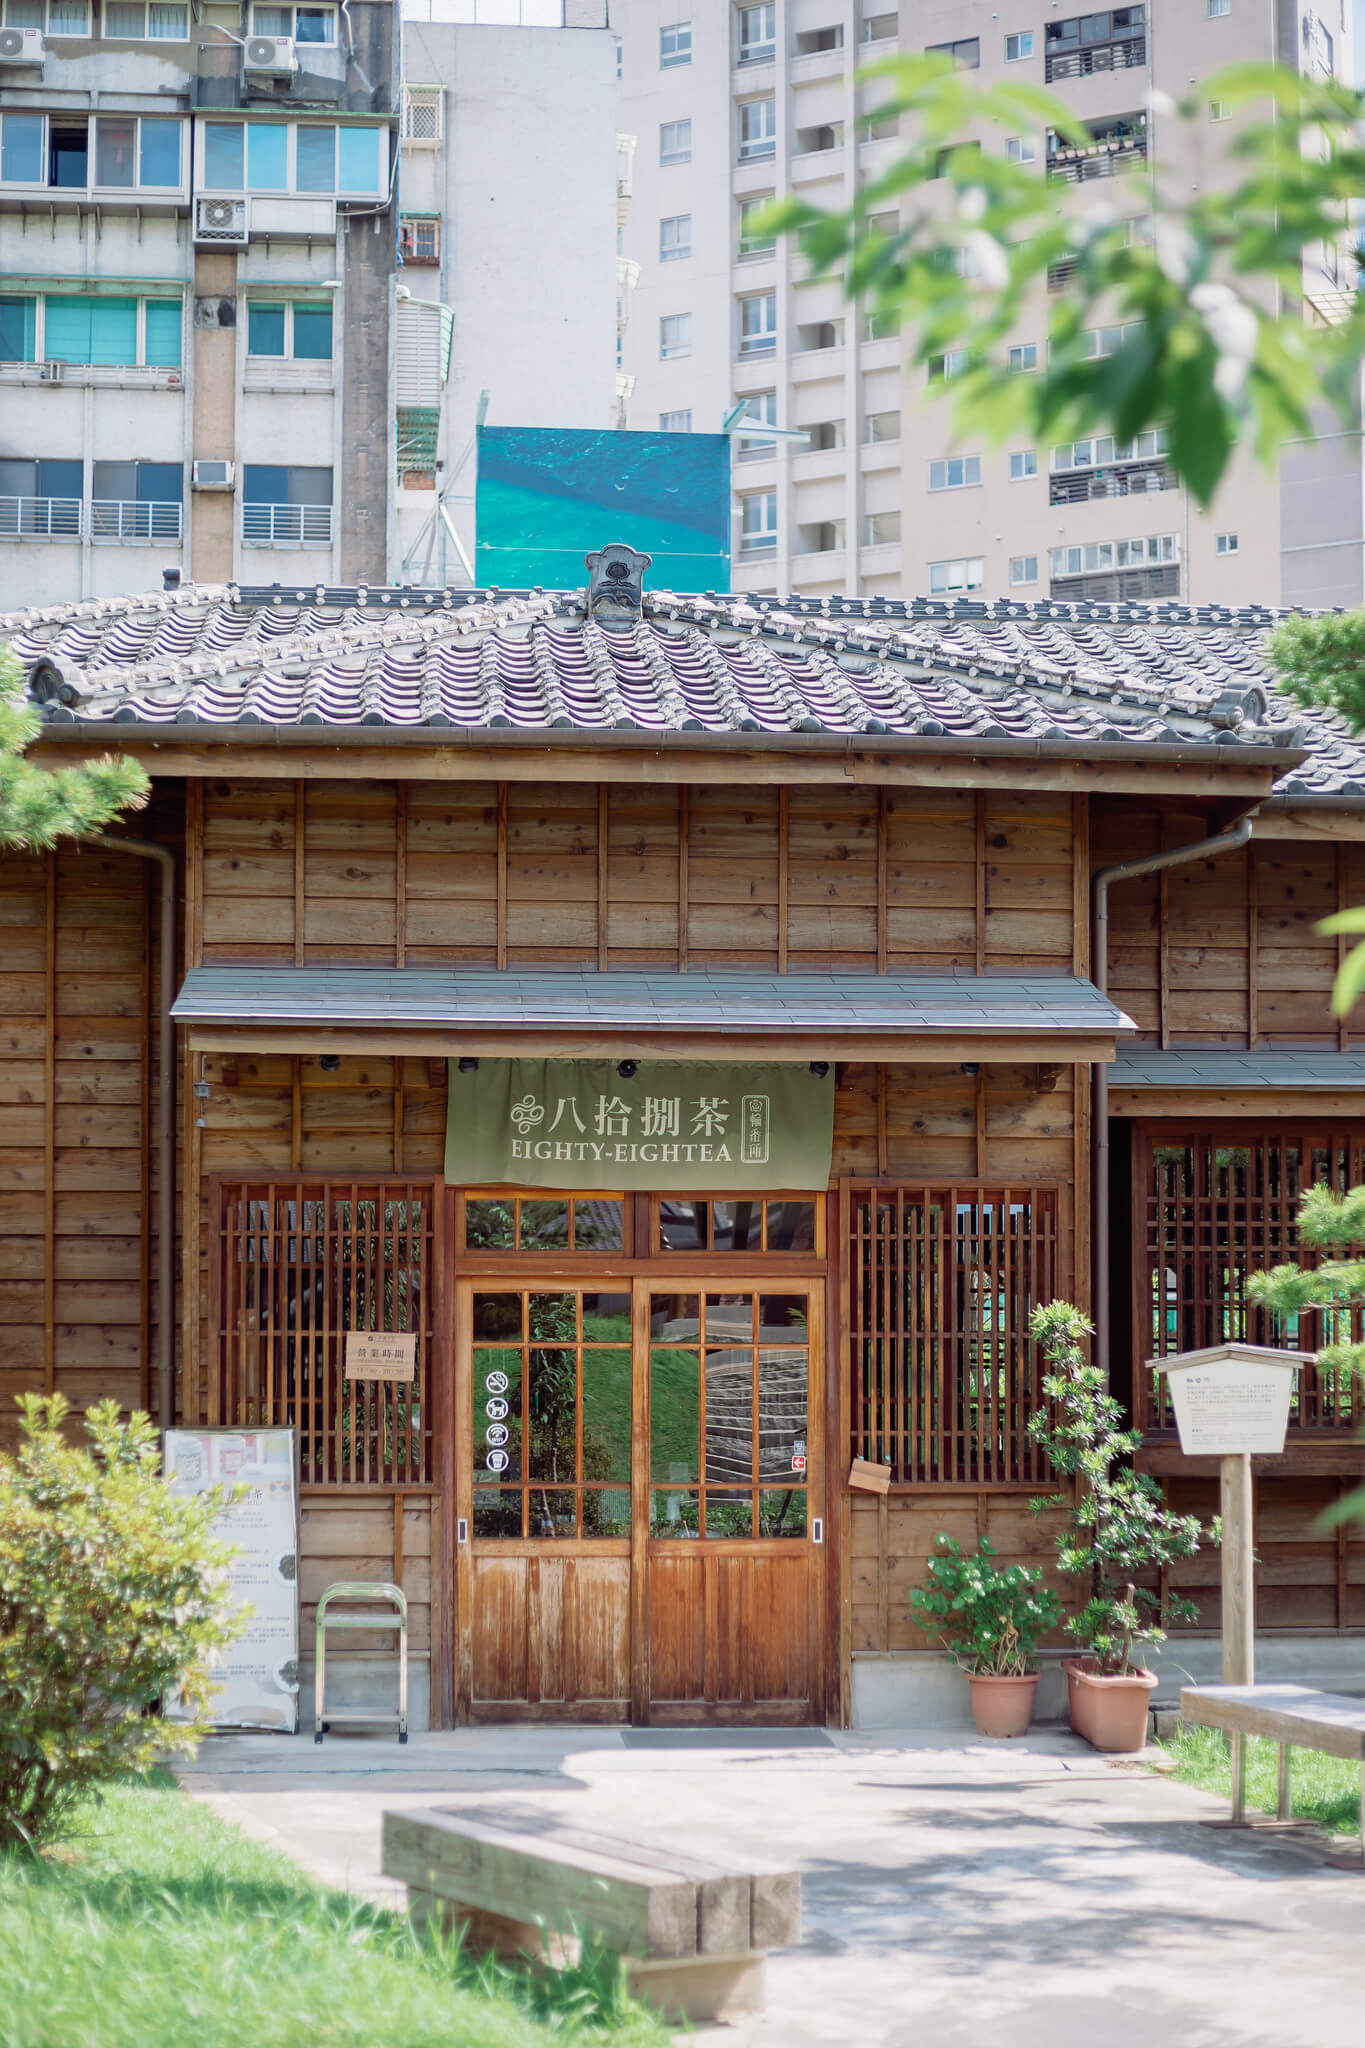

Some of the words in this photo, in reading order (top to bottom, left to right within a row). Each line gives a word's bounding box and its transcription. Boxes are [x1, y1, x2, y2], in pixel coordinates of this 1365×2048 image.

[548, 1095, 729, 1137] 八拾捌茶
[511, 1139, 732, 1162] EIGHTY-EIGHTEA
